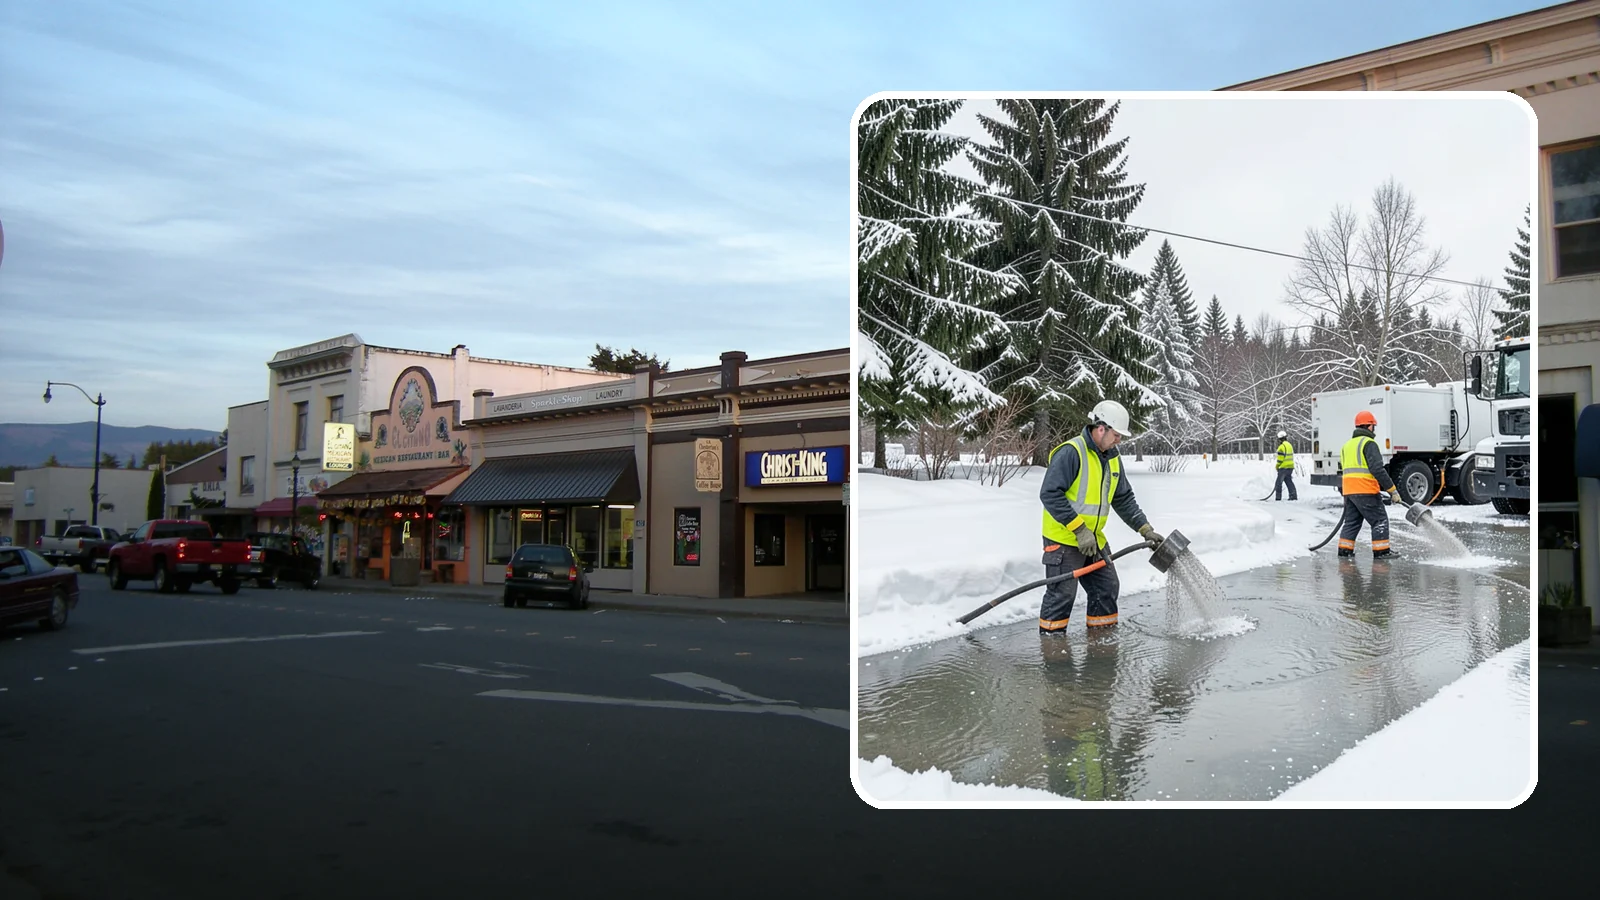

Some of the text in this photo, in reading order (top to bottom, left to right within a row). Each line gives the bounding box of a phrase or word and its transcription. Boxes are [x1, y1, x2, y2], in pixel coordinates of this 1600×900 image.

[595, 389, 623, 400] LAUNDRY
[493, 402, 522, 412] LAVANDERIA
[530, 394, 582, 409] Sparkle Shop
[392, 425, 402, 449] EL
[373, 450, 450, 464] MEXICAN RESTAURANT BAR
[696, 481, 722, 489] Coffee House
